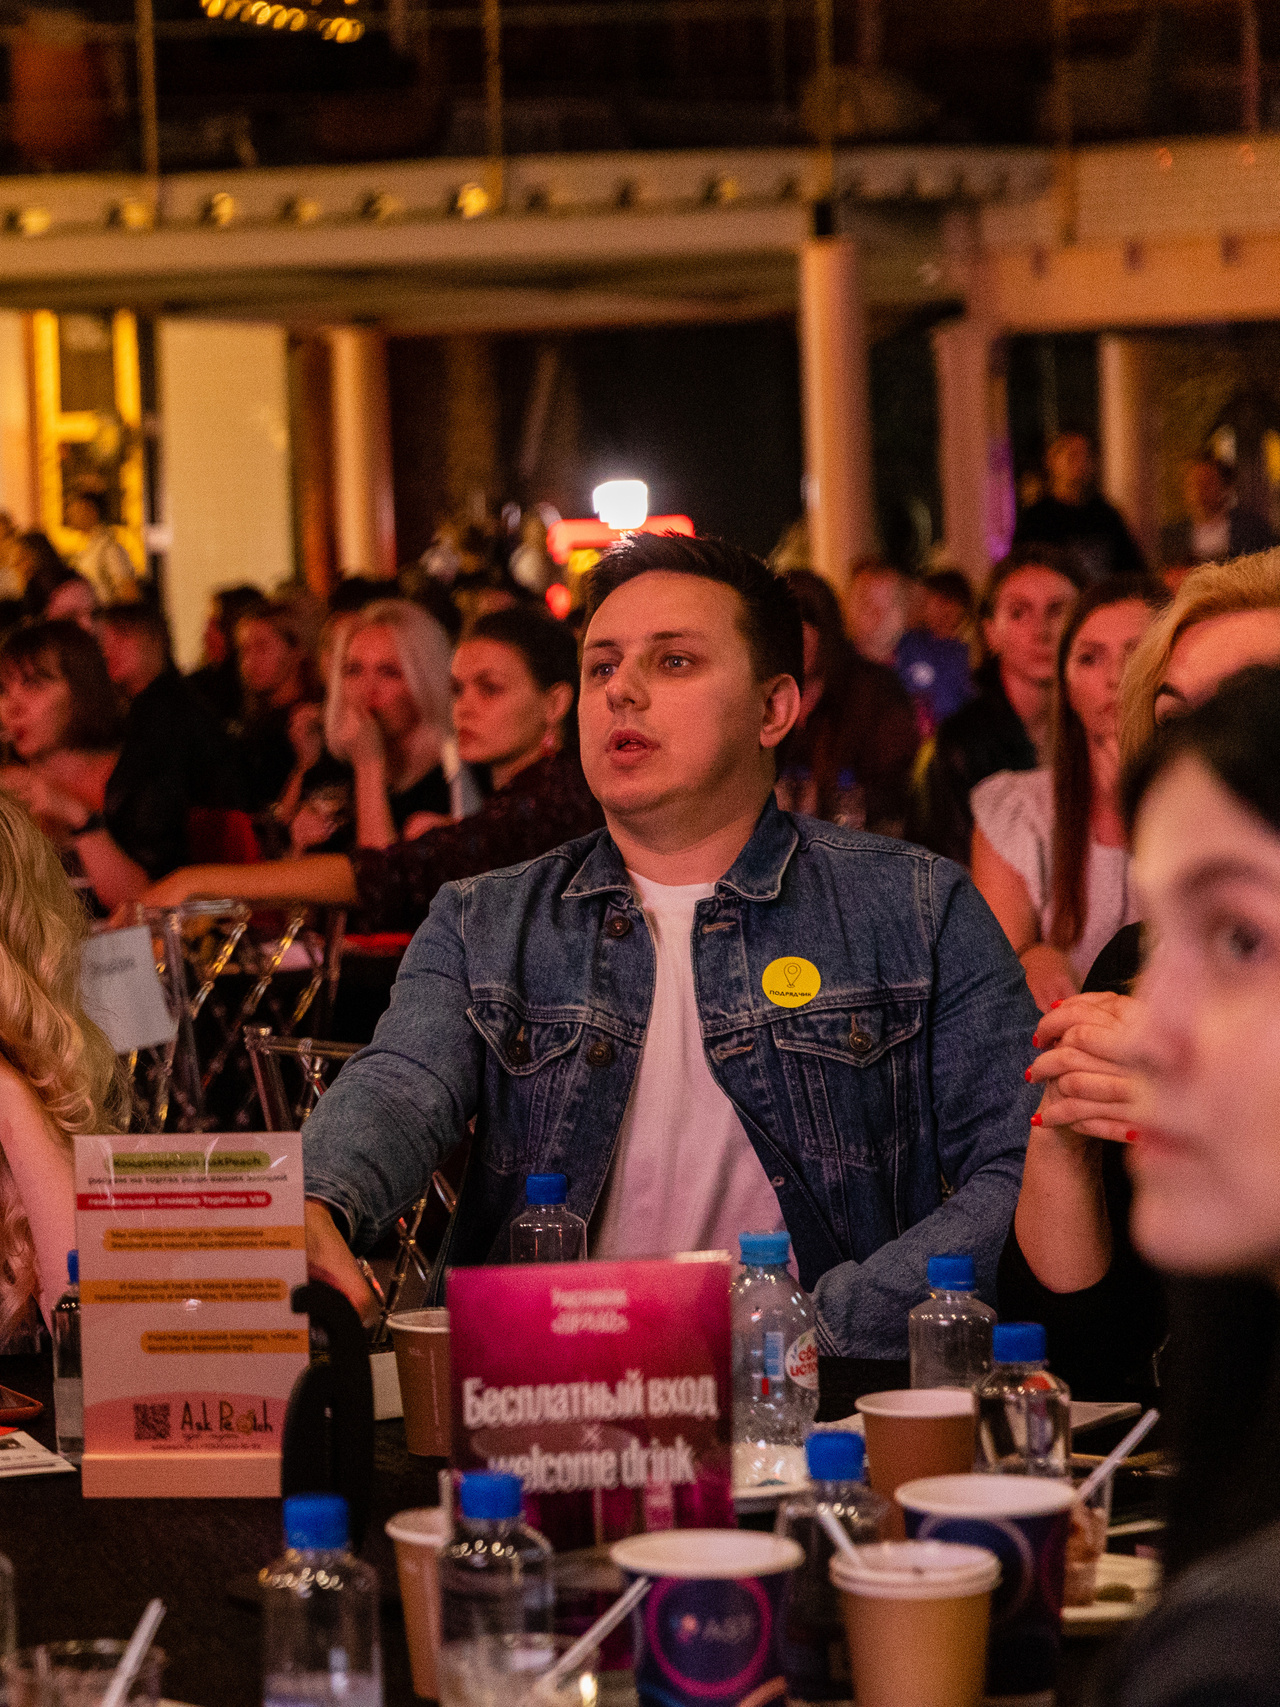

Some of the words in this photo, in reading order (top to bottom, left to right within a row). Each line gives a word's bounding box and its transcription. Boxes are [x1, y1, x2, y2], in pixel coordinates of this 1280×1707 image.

[463, 1368, 643, 1429] Бесплатный
[647, 1374, 719, 1419] вход
[621, 1435, 697, 1488] drink
